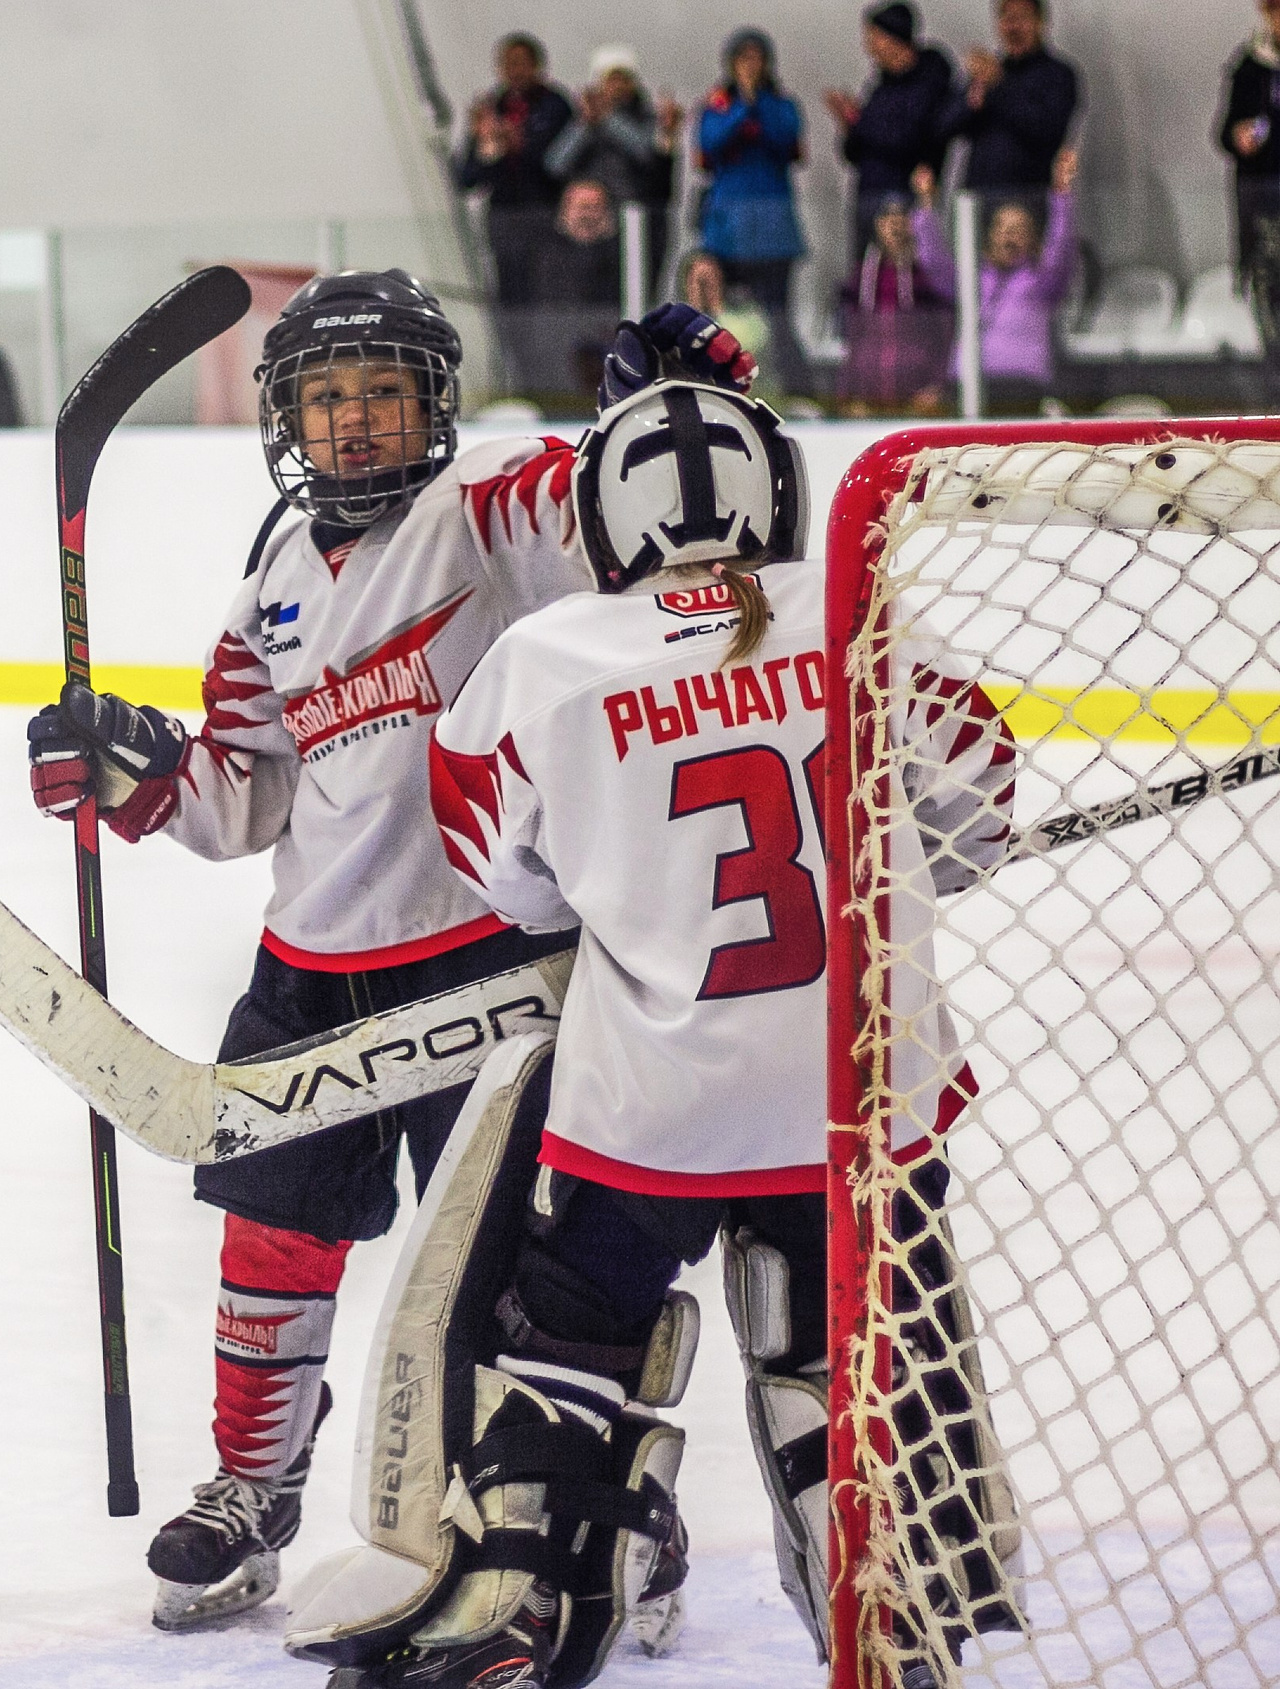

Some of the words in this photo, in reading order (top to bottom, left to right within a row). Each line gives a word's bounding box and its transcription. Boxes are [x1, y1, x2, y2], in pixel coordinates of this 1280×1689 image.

[312, 314, 383, 329] BAUER
[61, 546, 91, 689] BAU
[675, 584, 740, 608] STO
[337, 650, 438, 719] КРЫЛЬЯ
[668, 739, 827, 1001] 3
[233, 995, 559, 1117] VAPOR
[377, 1352, 416, 1530] BAUER
